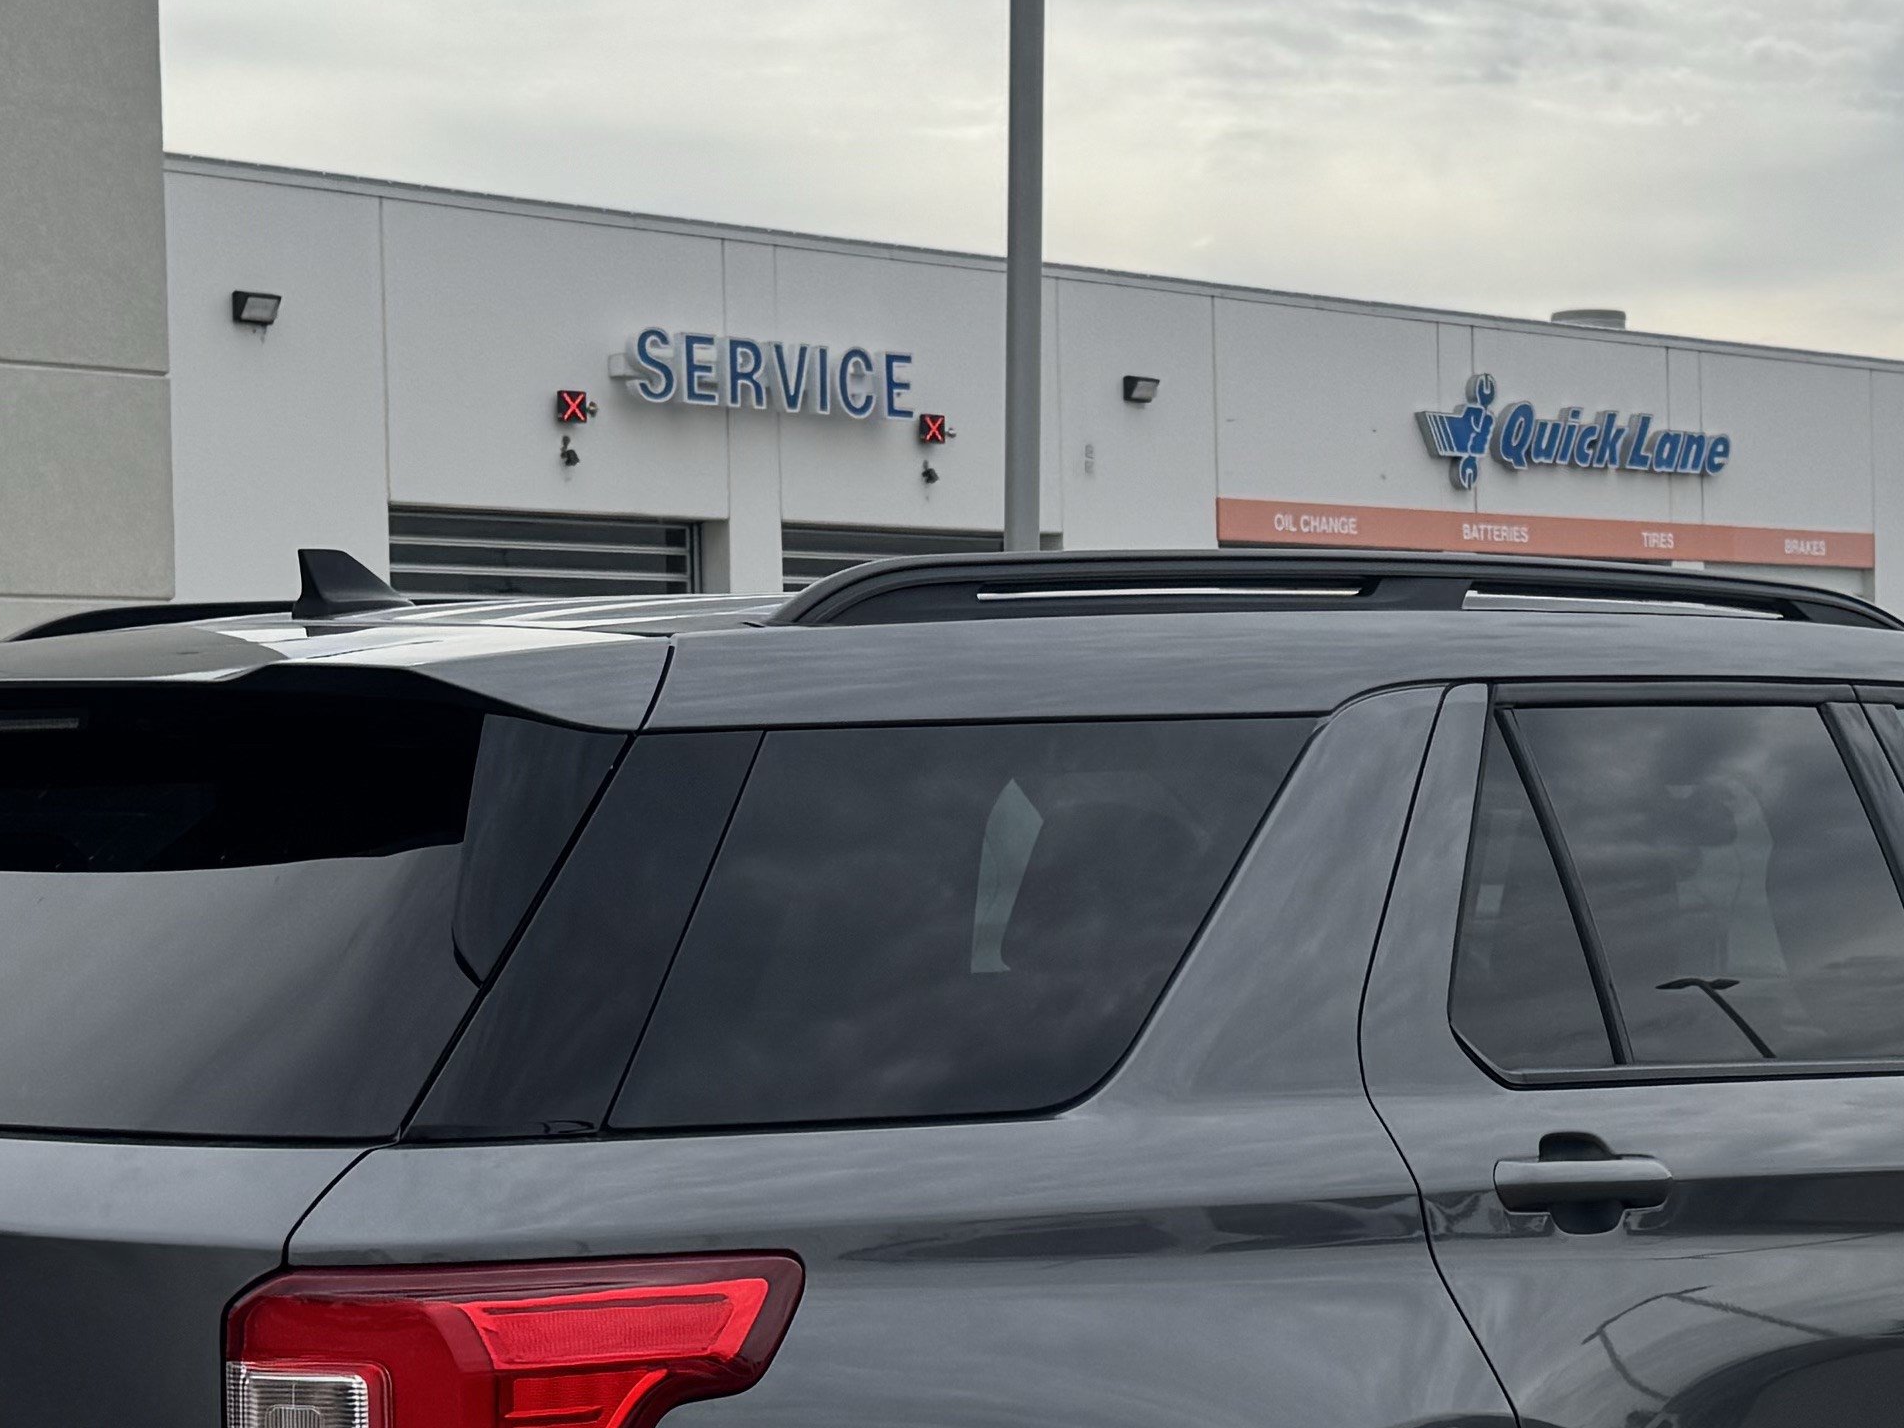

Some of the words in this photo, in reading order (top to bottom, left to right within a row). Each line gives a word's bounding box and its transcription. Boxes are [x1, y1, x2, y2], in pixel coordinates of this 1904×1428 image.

[633, 327, 915, 420] SERVICE
[1497, 400, 1627, 470] Quick
[1626, 413, 1731, 476] Lane
[1274, 513, 1297, 532] OIL
[1300, 515, 1358, 535] CHANGE
[1462, 523, 1529, 543] BATTERIES
[1641, 532, 1674, 549] TIRES
[1784, 538, 1826, 556] BRAKES
